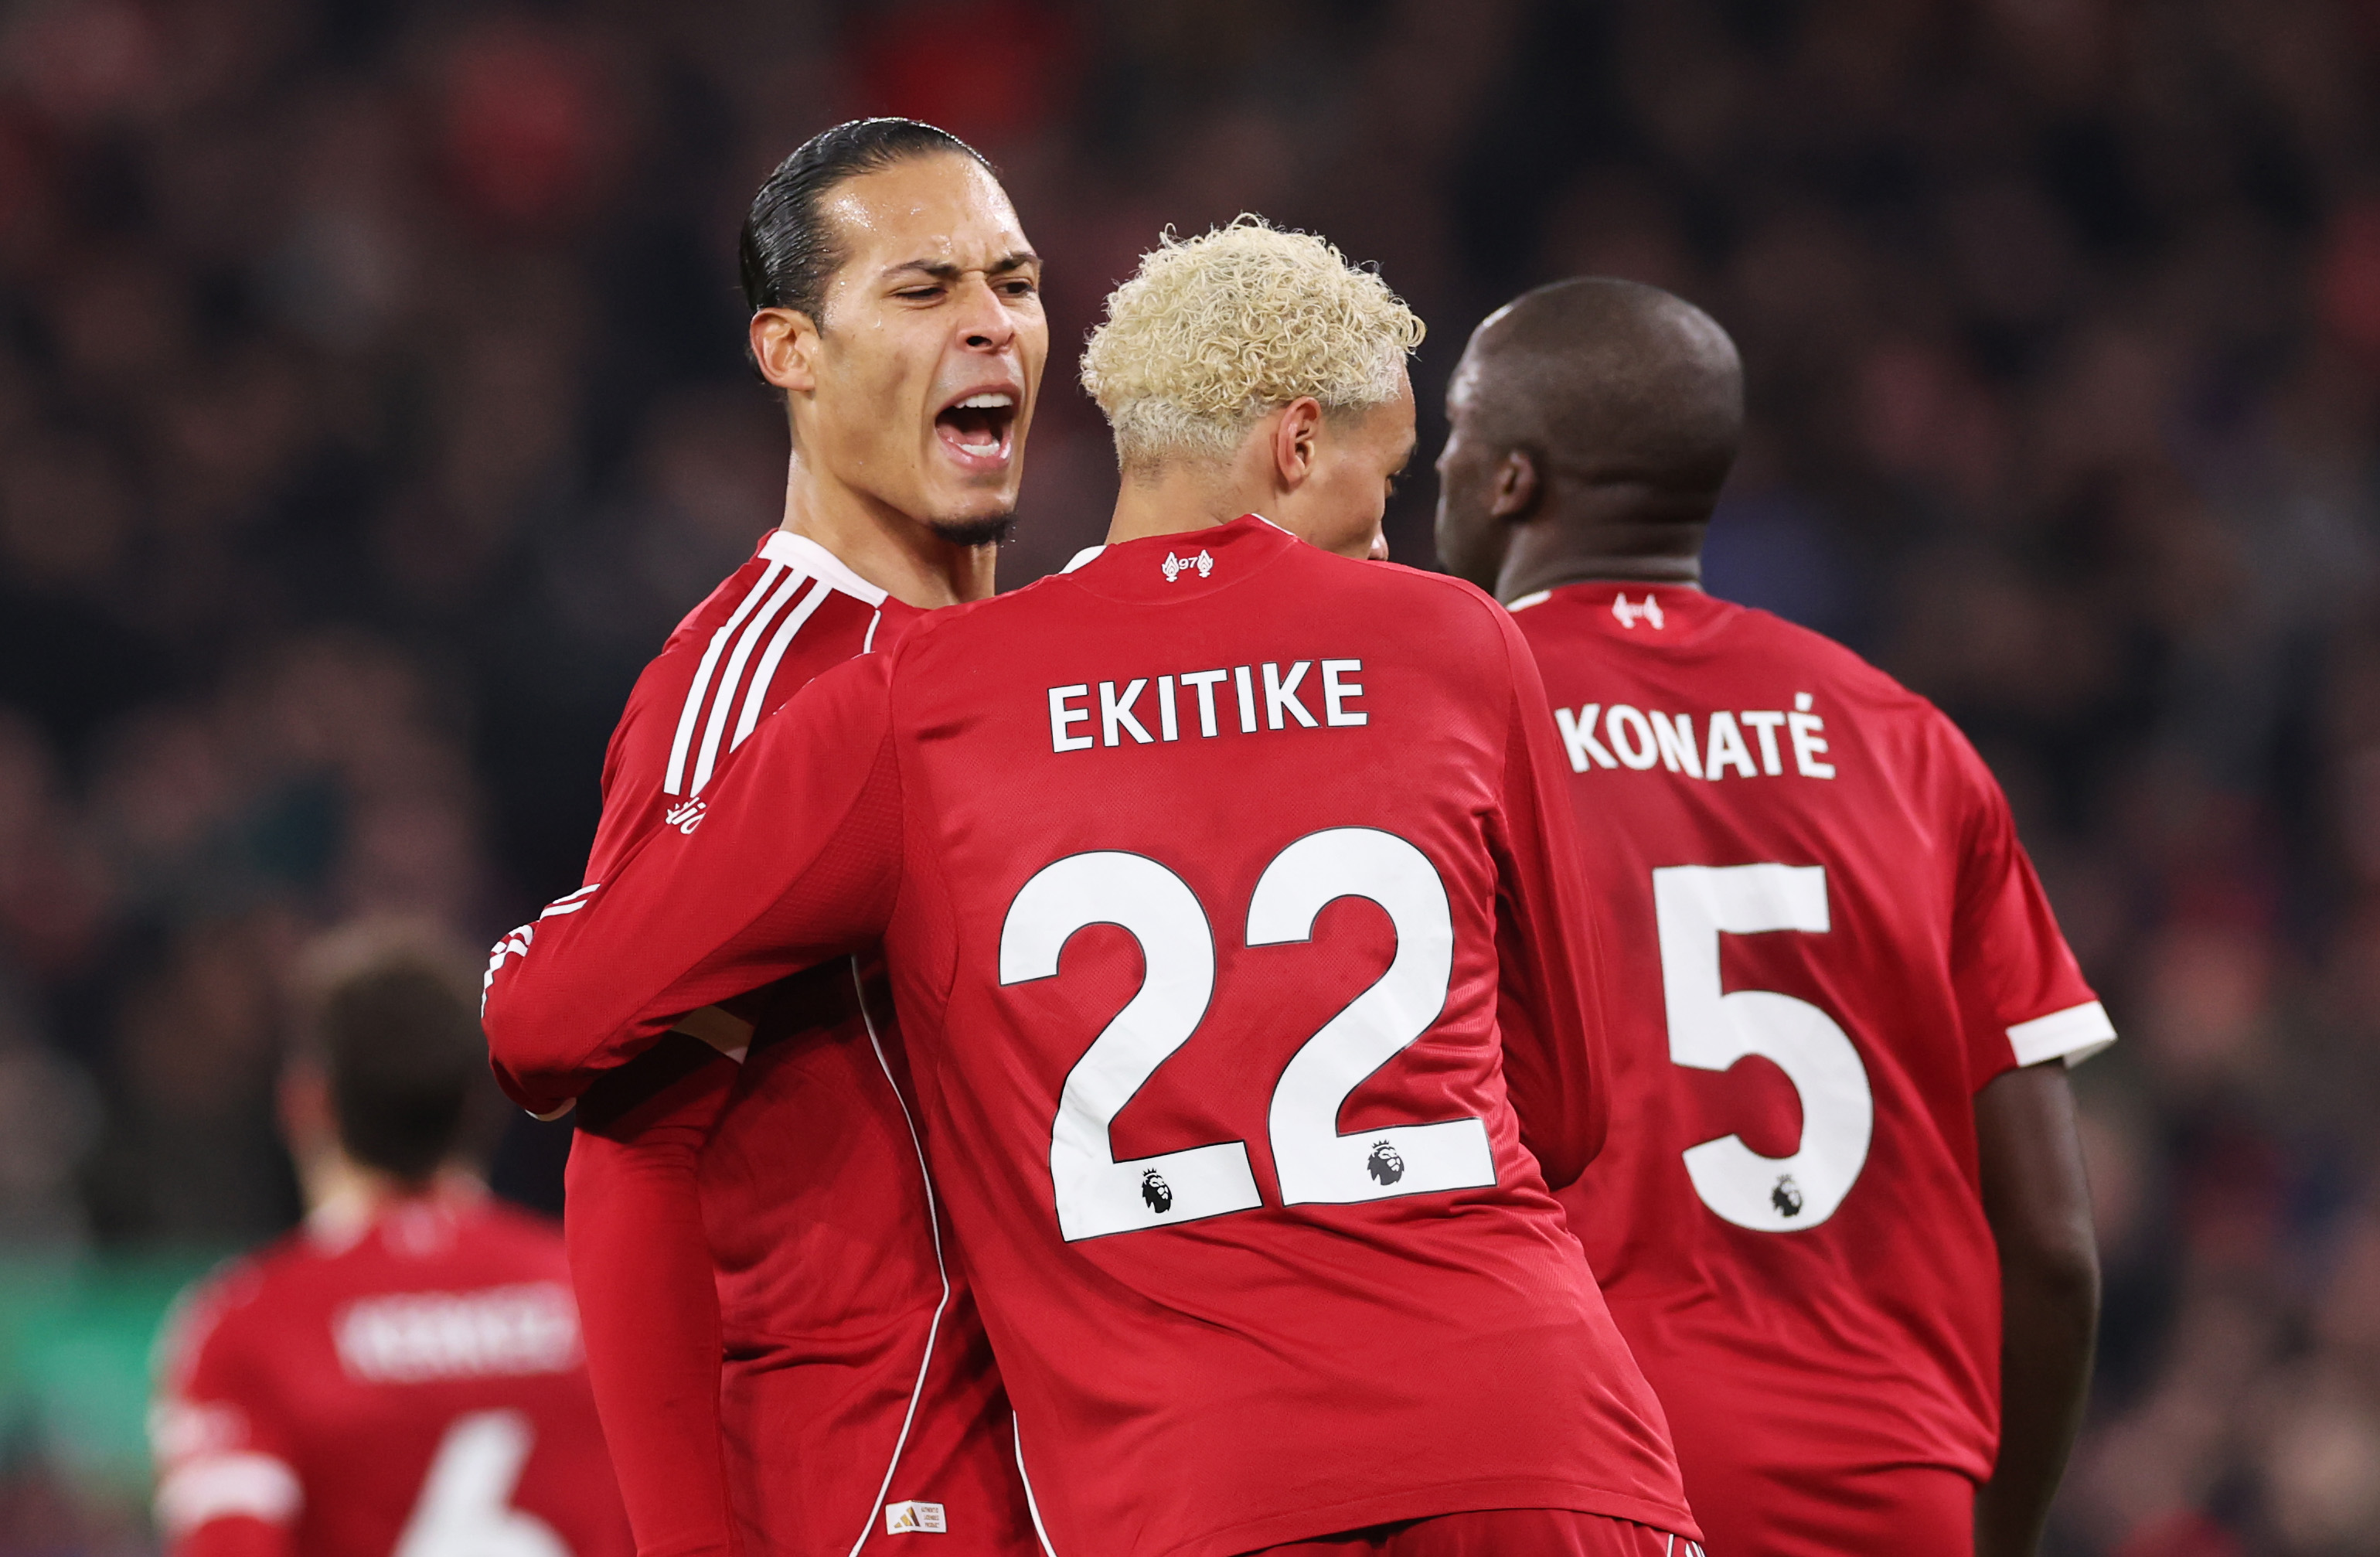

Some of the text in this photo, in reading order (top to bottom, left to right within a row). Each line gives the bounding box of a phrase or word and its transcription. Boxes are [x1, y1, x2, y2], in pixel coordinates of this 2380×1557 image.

[1178, 556, 1198, 570] 97
[1047, 658, 1369, 754] EKITIKE
[1554, 691, 1837, 782] KONATÉ
[998, 826, 1498, 1243] 22
[1651, 861, 1874, 1234] 5
